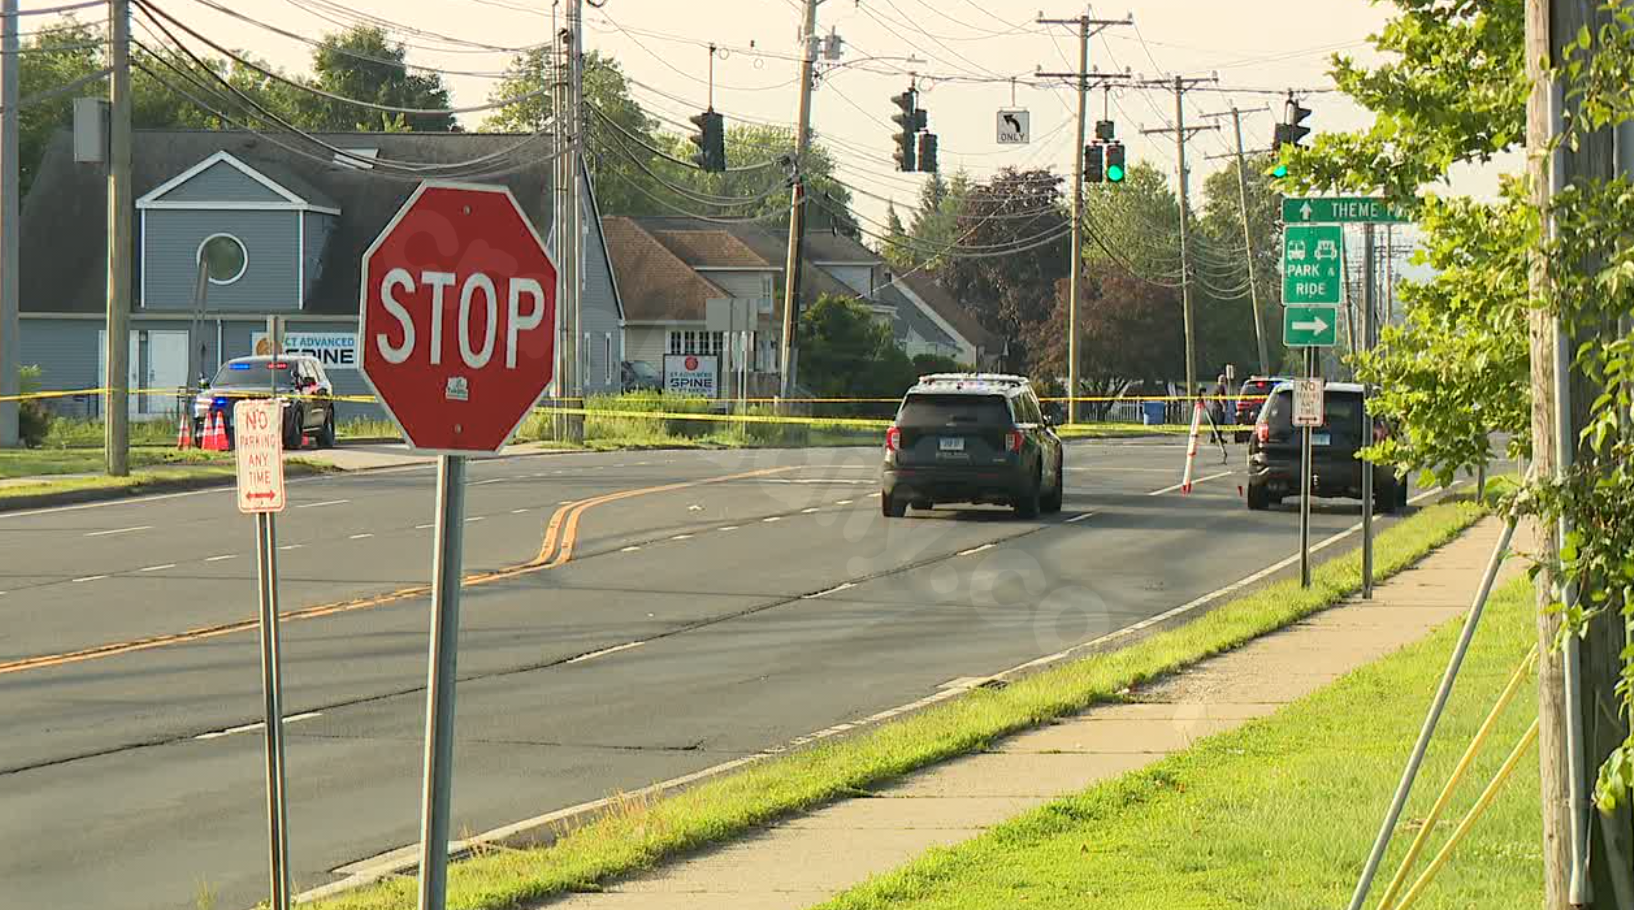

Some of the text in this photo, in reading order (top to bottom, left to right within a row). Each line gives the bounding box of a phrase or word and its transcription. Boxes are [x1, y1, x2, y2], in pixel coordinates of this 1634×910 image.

[1001, 133, 1025, 141] ONLY
[1331, 202, 1378, 217] THEME
[1287, 264, 1335, 277] PARK &
[1296, 282, 1327, 295] RIDE
[376, 267, 545, 370] STOP
[285, 337, 354, 346] CT ADVANCED
[670, 378, 713, 387] SPINE
[1301, 382, 1316, 391] NO
[246, 409, 268, 430] NO
[240, 434, 276, 448] PARKING
[249, 454, 268, 467] ANY
[249, 470, 271, 485] TIME
